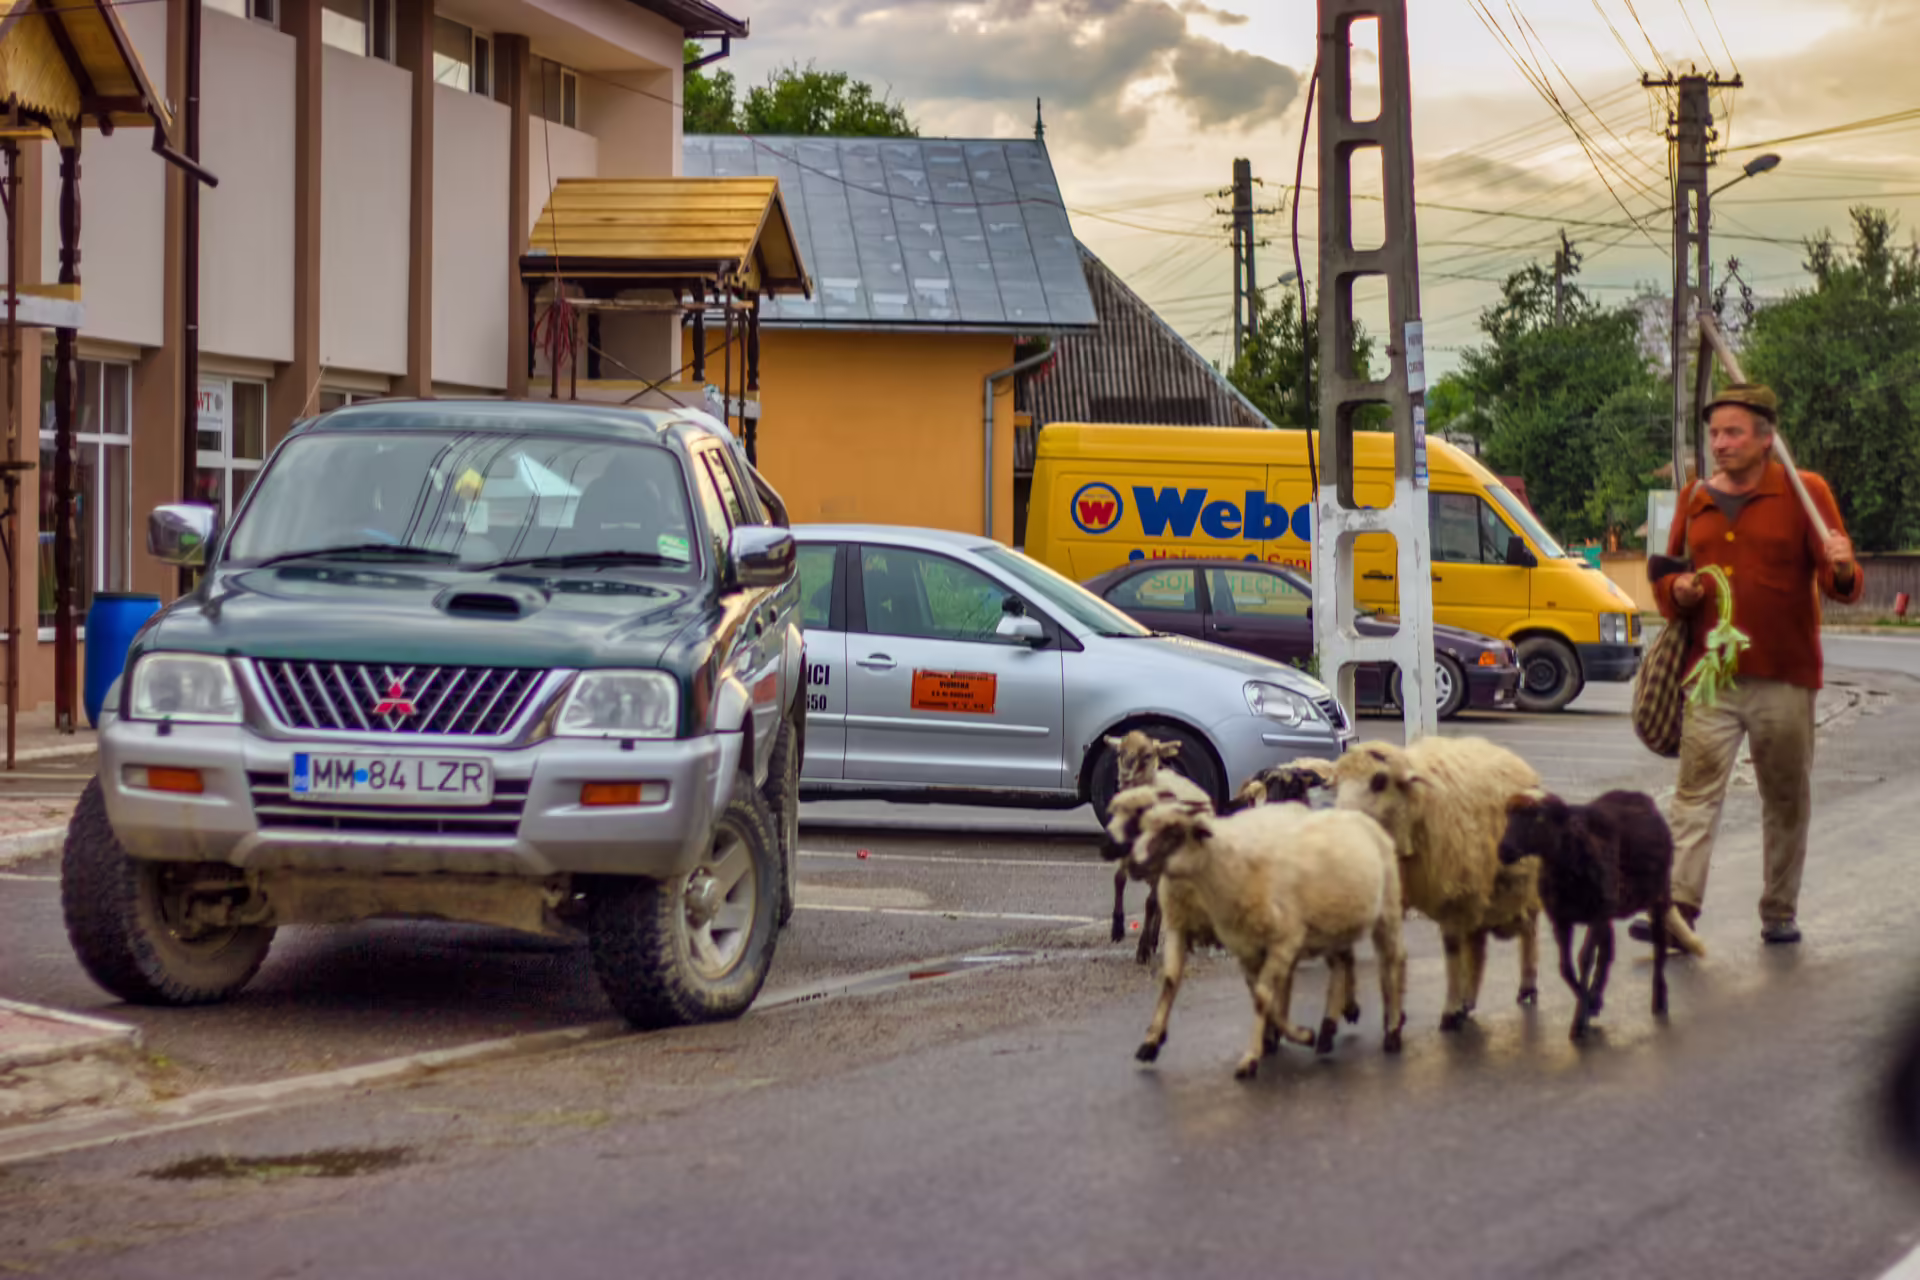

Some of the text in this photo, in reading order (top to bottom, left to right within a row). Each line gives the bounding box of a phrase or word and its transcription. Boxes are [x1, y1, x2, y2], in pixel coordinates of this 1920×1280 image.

[1078, 501, 1114, 525] W
[312, 758, 484, 793] MM 84 LZR
